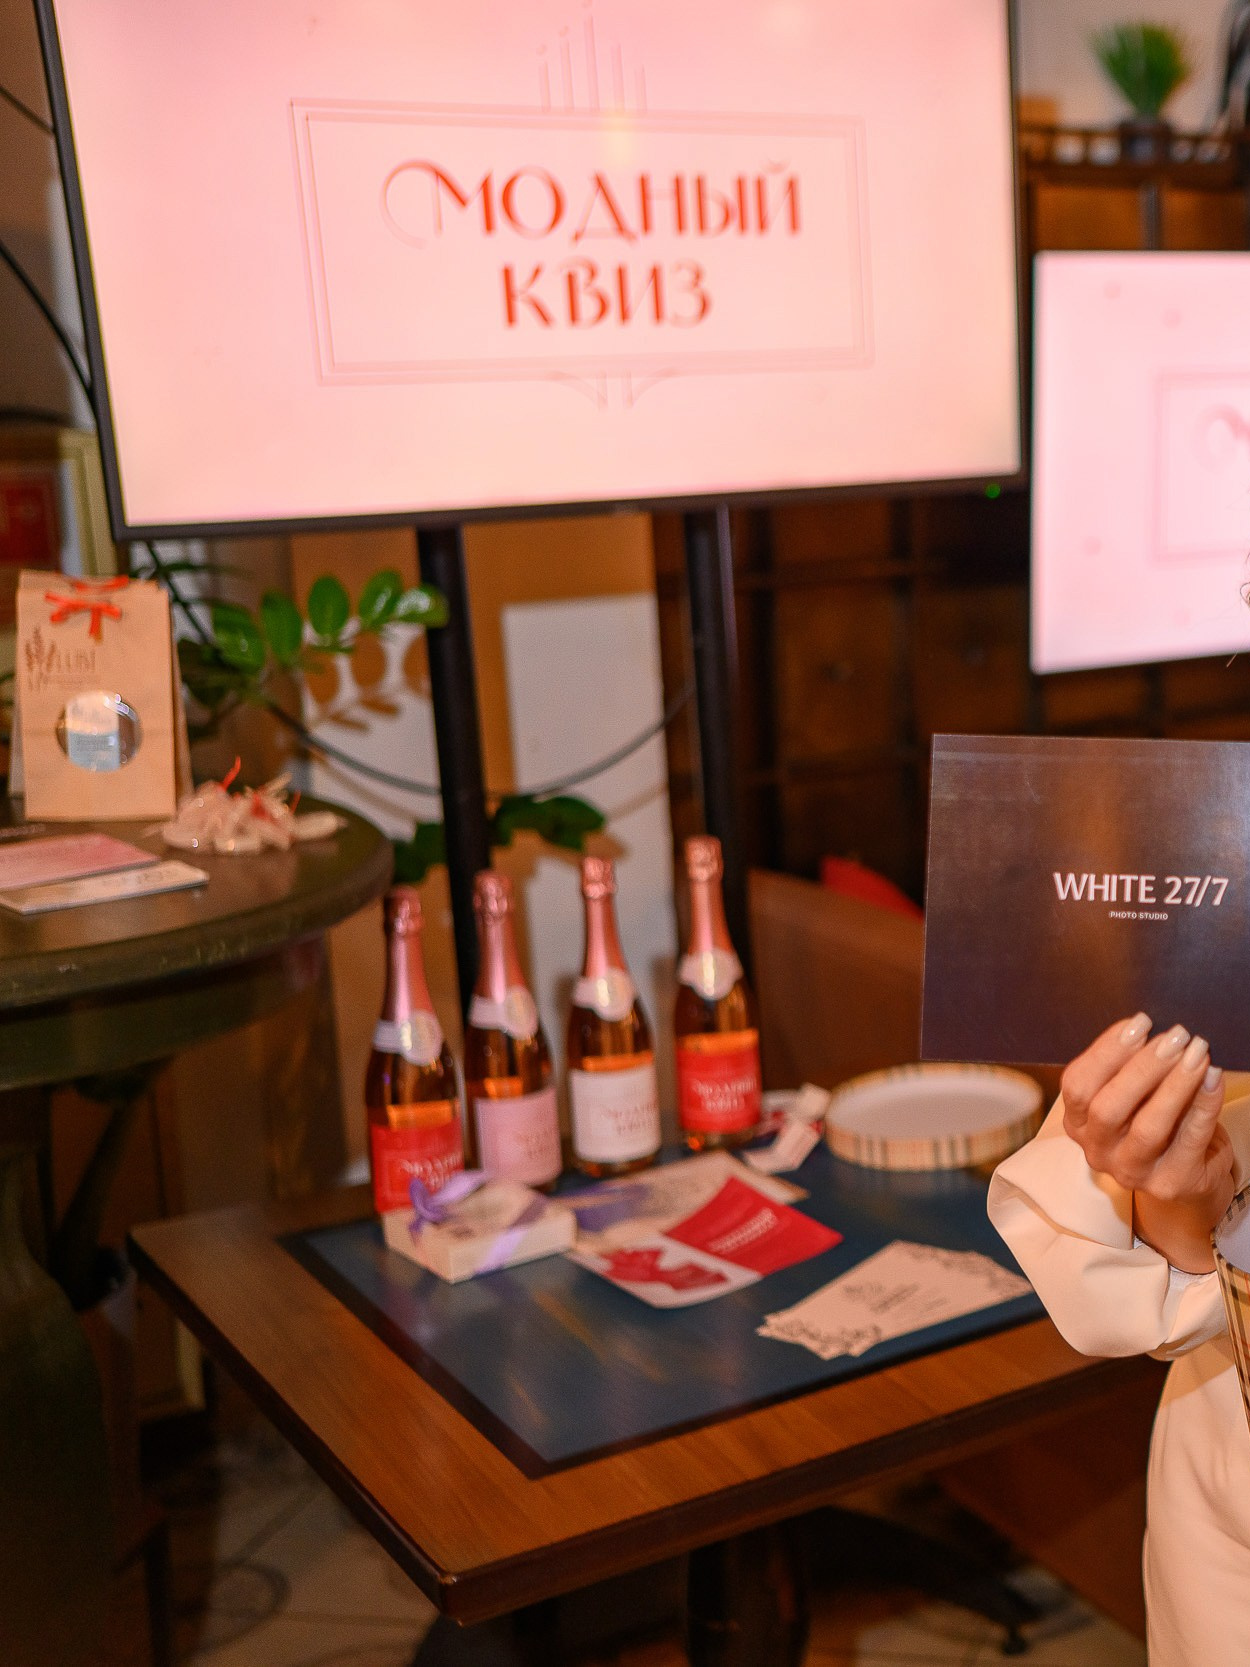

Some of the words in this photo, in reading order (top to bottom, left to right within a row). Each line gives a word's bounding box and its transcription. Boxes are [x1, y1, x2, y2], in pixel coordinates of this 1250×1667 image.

[380, 157, 802, 249] МОДНЫЙ
[501, 254, 713, 330] КВИЗ
[1053, 871, 1157, 904] WHITE
[1163, 875, 1230, 908] 27/7
[1109, 910, 1138, 920] PHOTO
[1138, 911, 1169, 921] STUDIO
